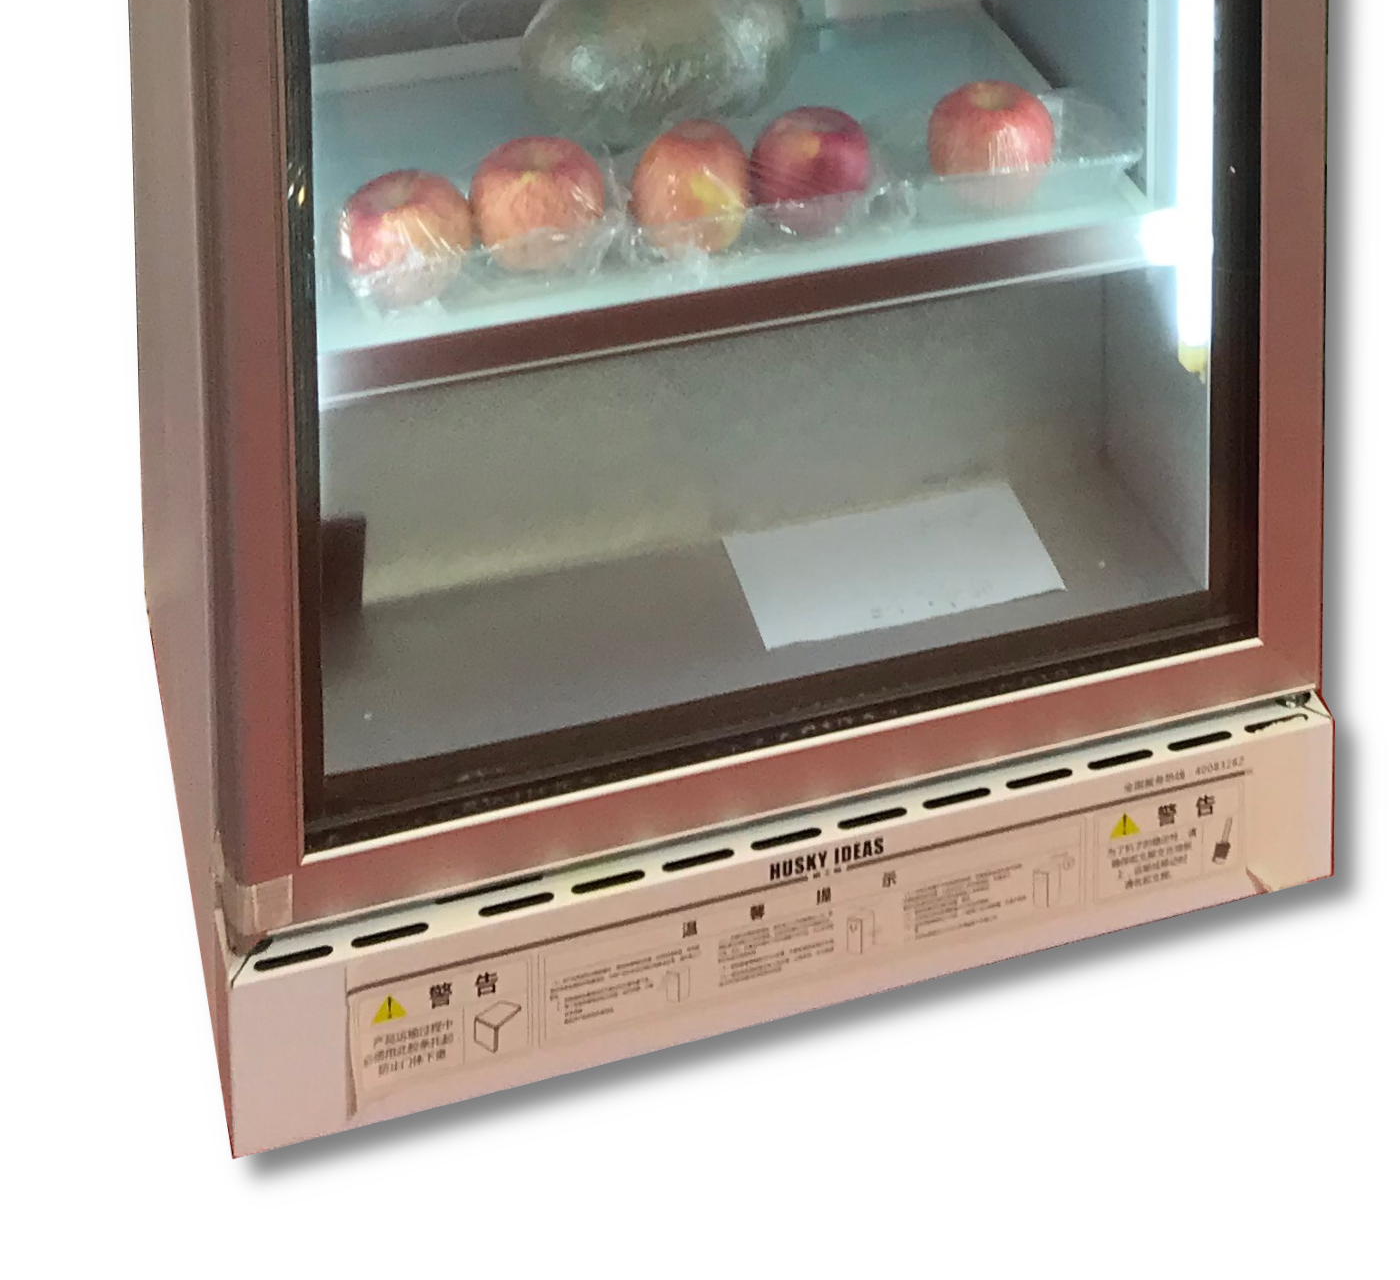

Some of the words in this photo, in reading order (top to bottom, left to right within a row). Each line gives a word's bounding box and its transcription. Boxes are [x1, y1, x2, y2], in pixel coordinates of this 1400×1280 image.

[769, 850, 828, 881] HUSKY
[834, 837, 884, 865] IDEAS
[429, 971, 499, 1009] 警告
